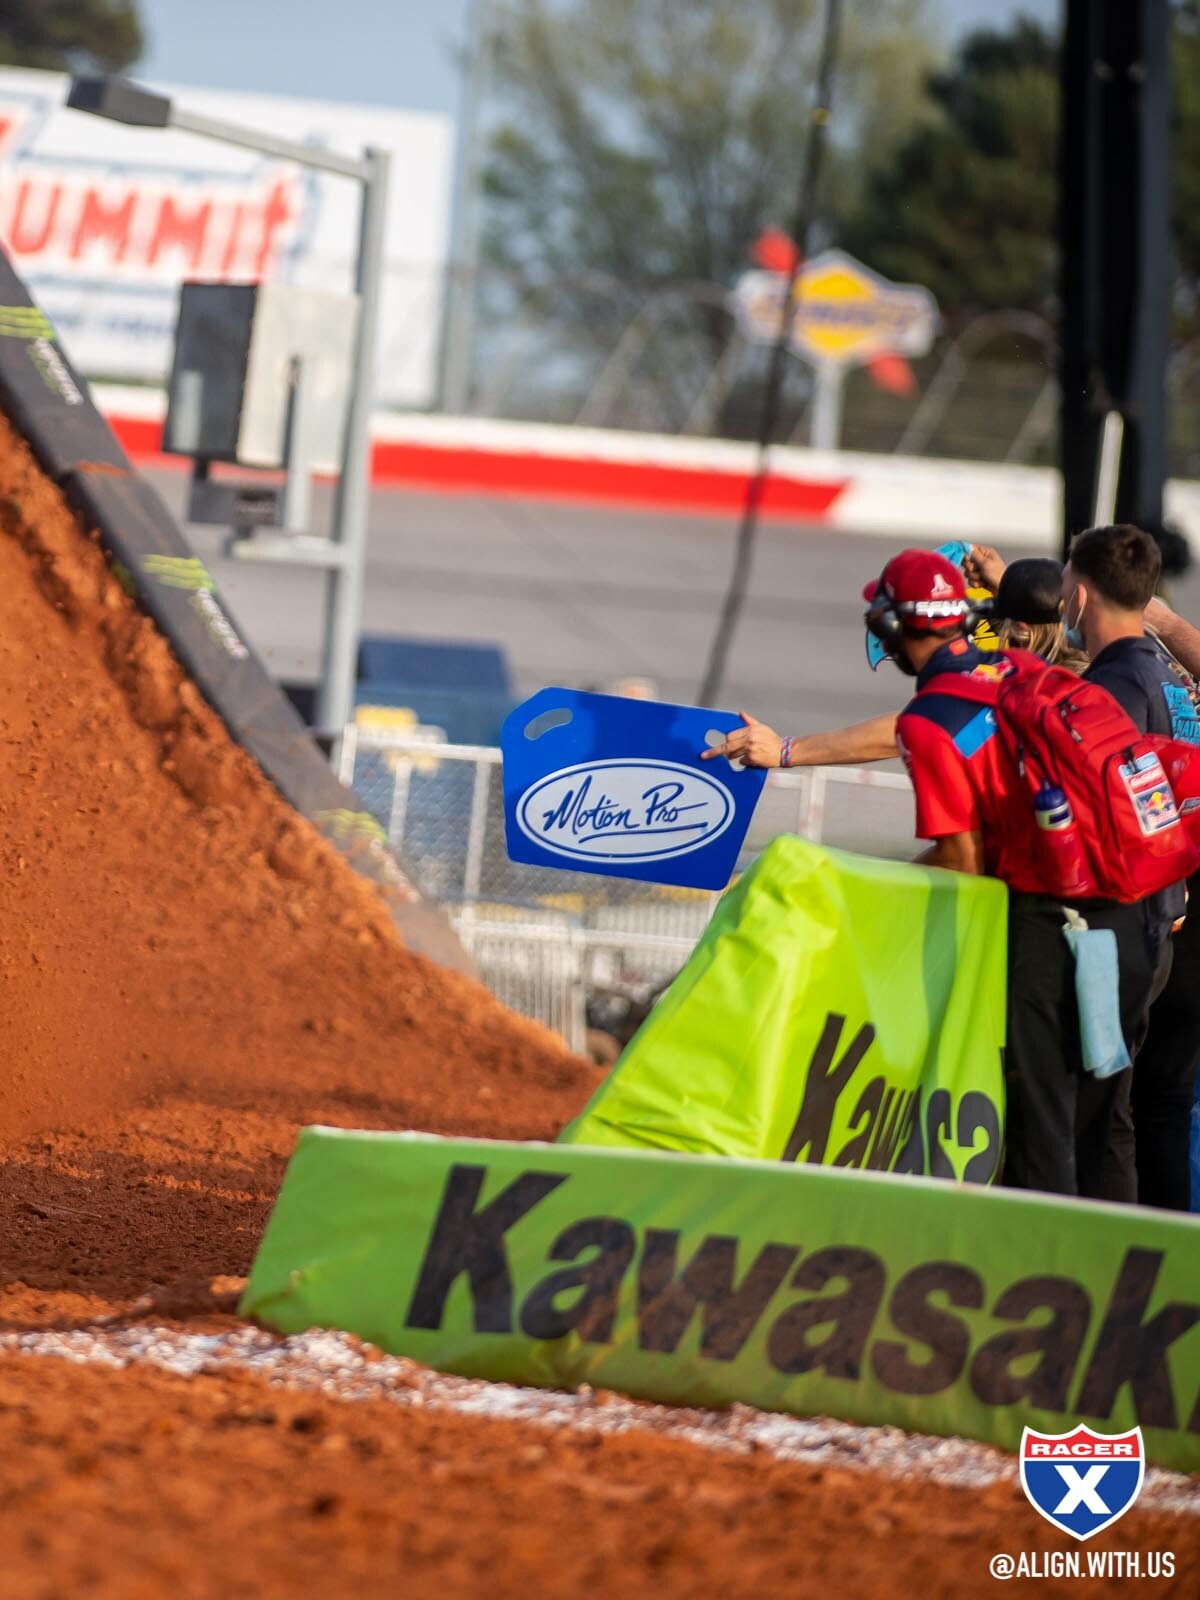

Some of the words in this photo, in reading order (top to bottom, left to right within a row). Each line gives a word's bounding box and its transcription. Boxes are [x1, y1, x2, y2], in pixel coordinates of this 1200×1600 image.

[542, 775, 639, 835] Motion
[642, 782, 709, 825] Pro
[404, 1163, 1200, 1436] Kawasak
